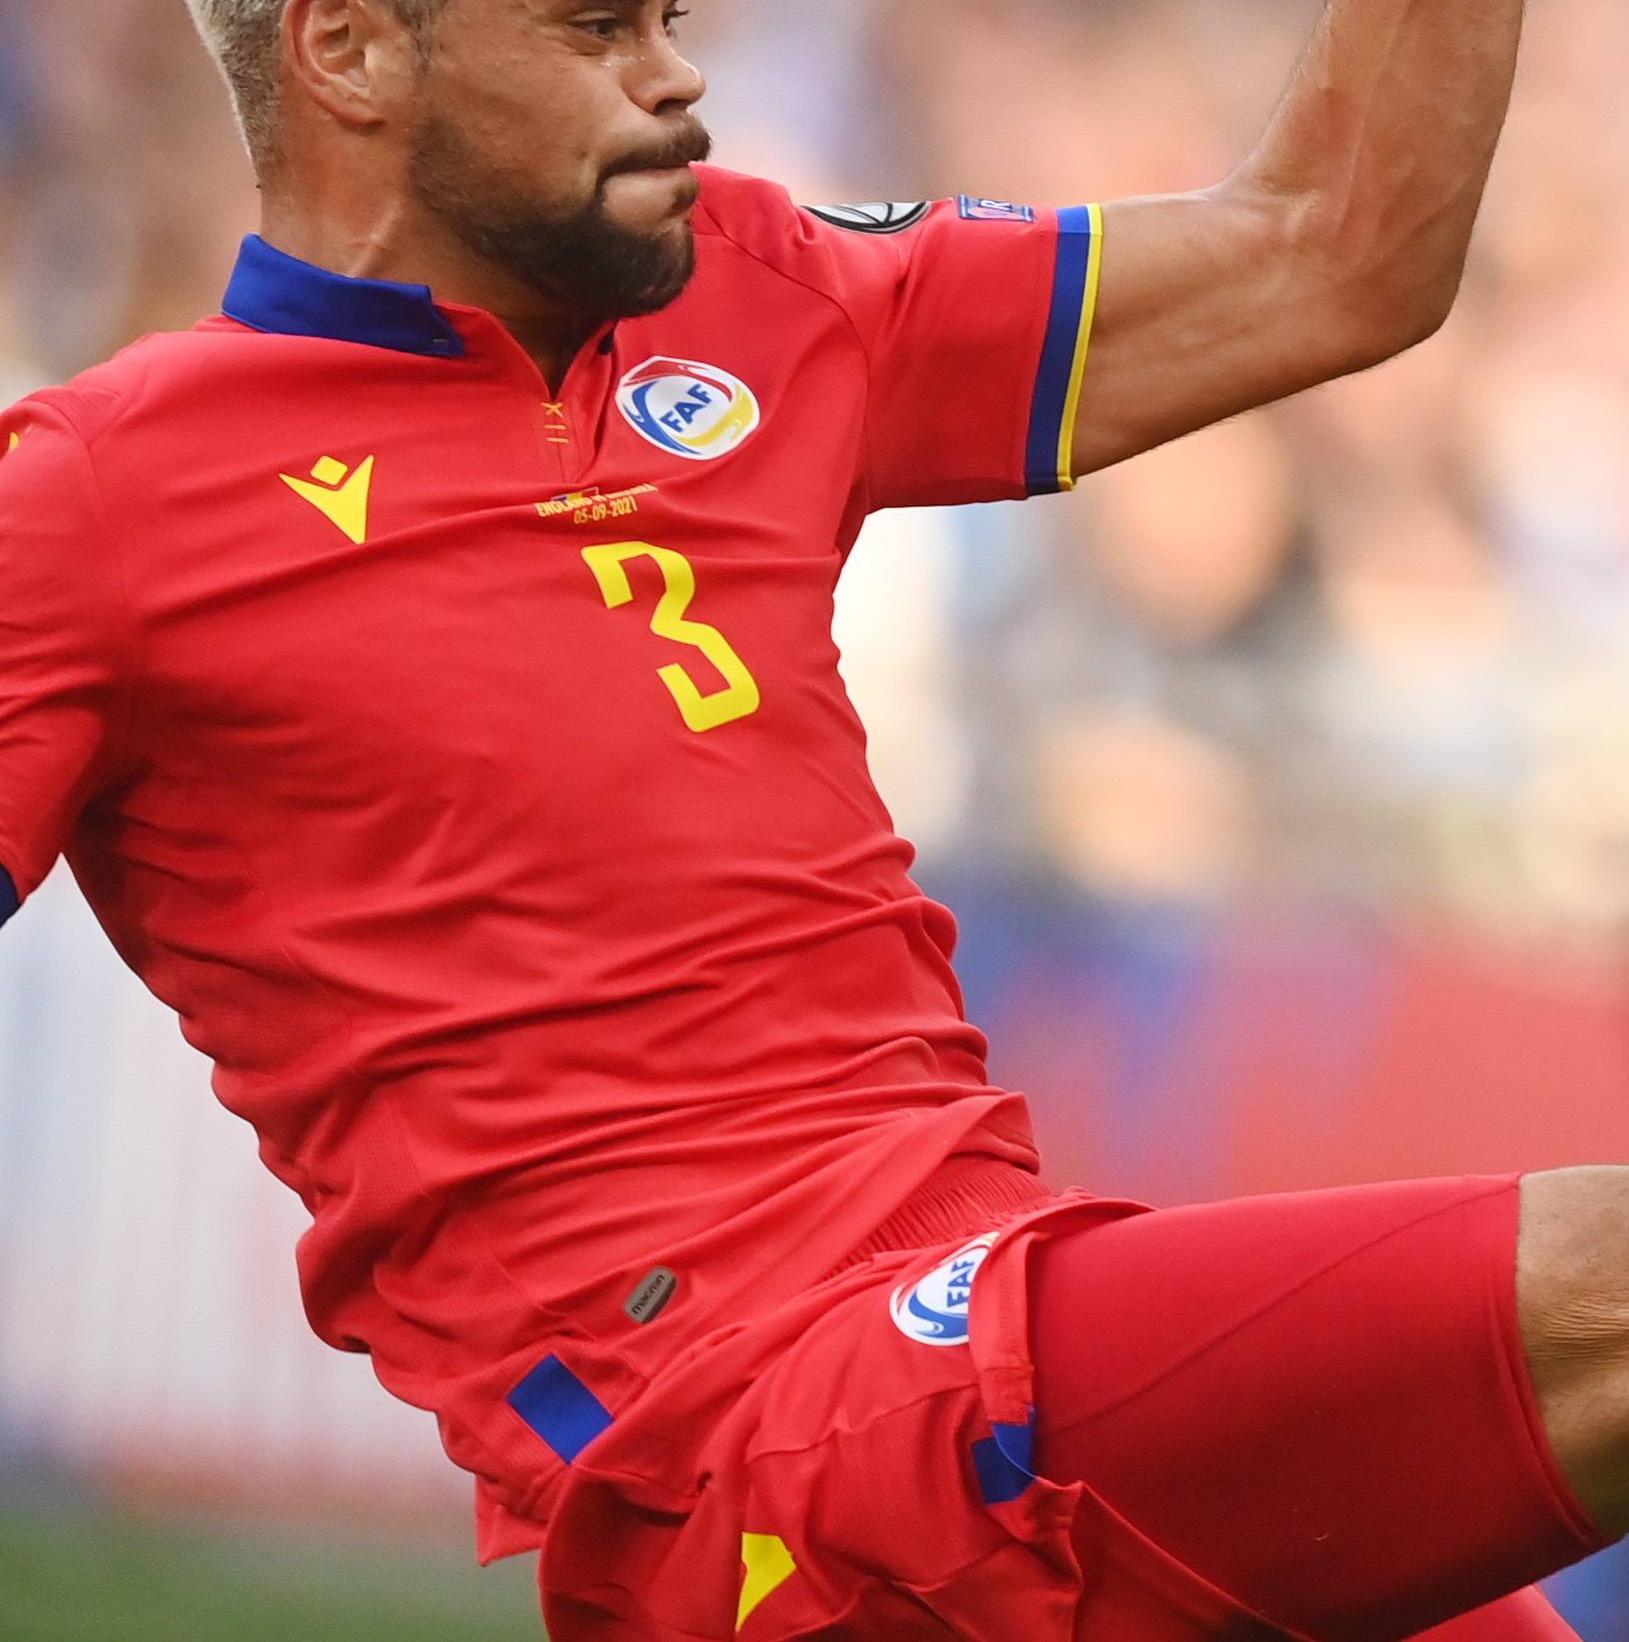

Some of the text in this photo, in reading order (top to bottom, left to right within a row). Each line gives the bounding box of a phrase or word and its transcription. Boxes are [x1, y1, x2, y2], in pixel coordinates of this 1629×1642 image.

[659, 383, 712, 433] FAF
[573, 495, 638, 524] 05-09-2021
[580, 540, 761, 733] 3
[946, 1260, 975, 1308] FAF
